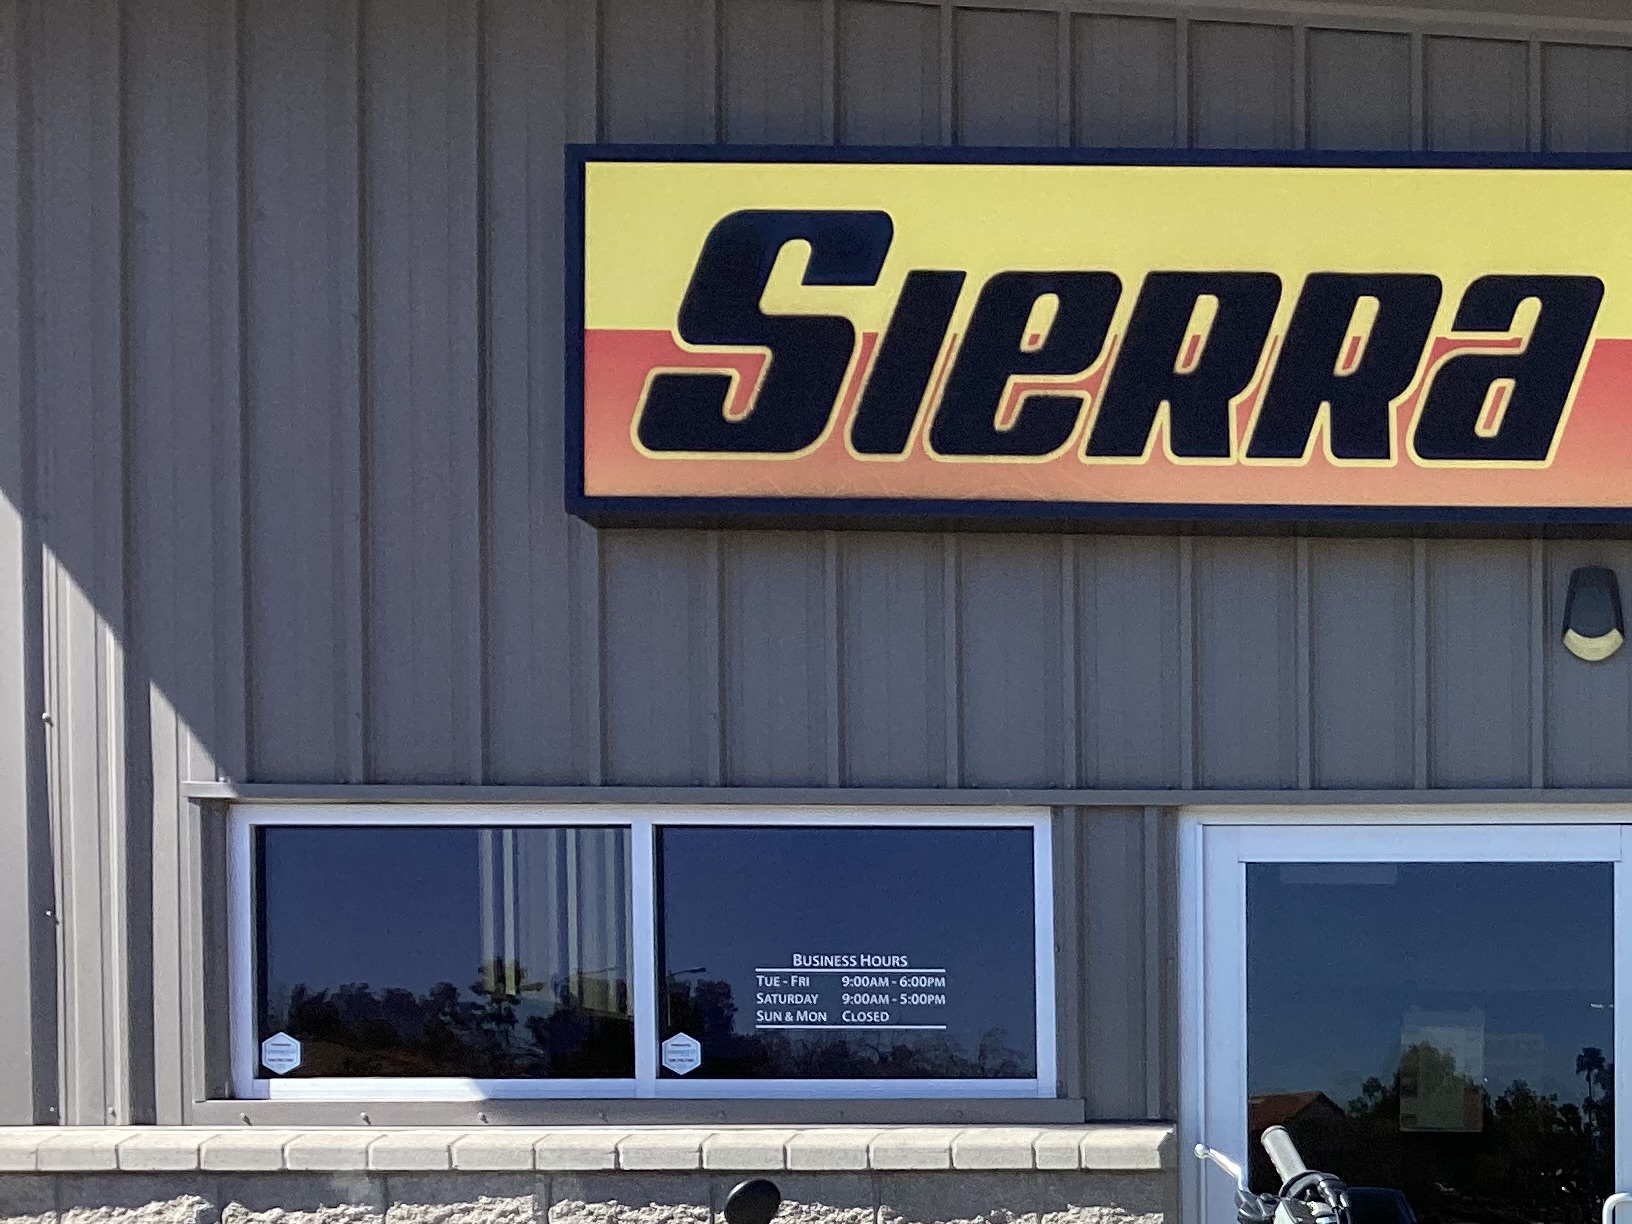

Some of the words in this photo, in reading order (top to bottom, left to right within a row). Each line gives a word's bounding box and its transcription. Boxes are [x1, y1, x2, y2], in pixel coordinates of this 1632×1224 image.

[756, 975, 781, 987] TUE
[790, 975, 810, 987] FRI
[841, 975, 890, 988] 9:00AM
[899, 975, 946, 988] 6:00PM
[755, 993, 819, 1005] SATURDAY
[841, 993, 890, 1005] 9:00AM
[899, 993, 946, 1005] 5:00PM
[755, 1010, 782, 1022] SUN
[784, 1011, 794, 1022] &
[796, 1010, 827, 1022] MON
